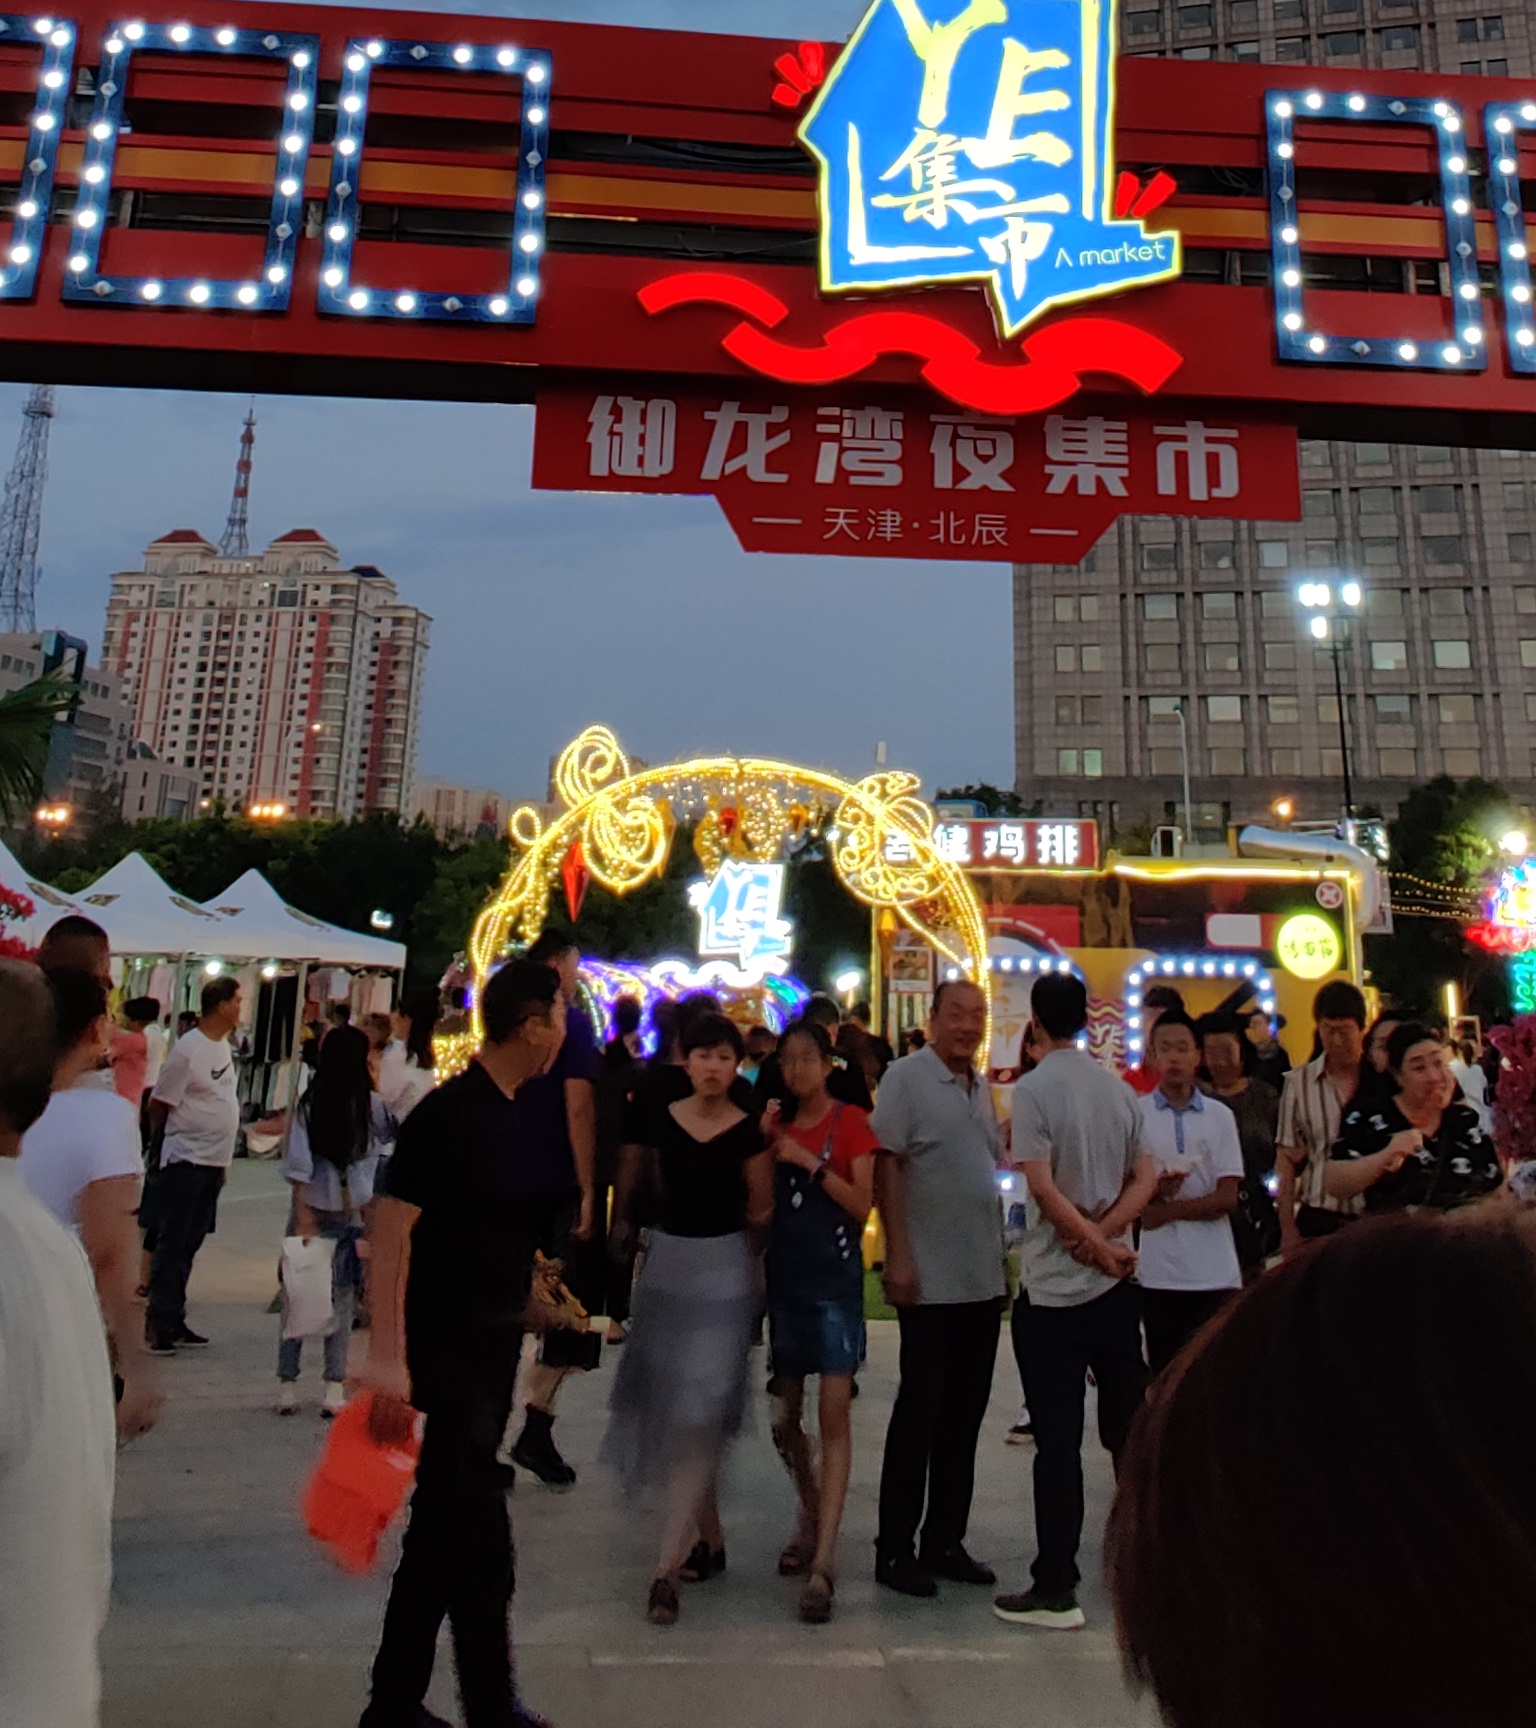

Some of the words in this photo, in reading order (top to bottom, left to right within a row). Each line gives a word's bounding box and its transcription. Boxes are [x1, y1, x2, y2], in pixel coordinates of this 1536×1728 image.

[1079, 240, 1166, 267] market
[585, 393, 1243, 503] 御龙湾夜集市
